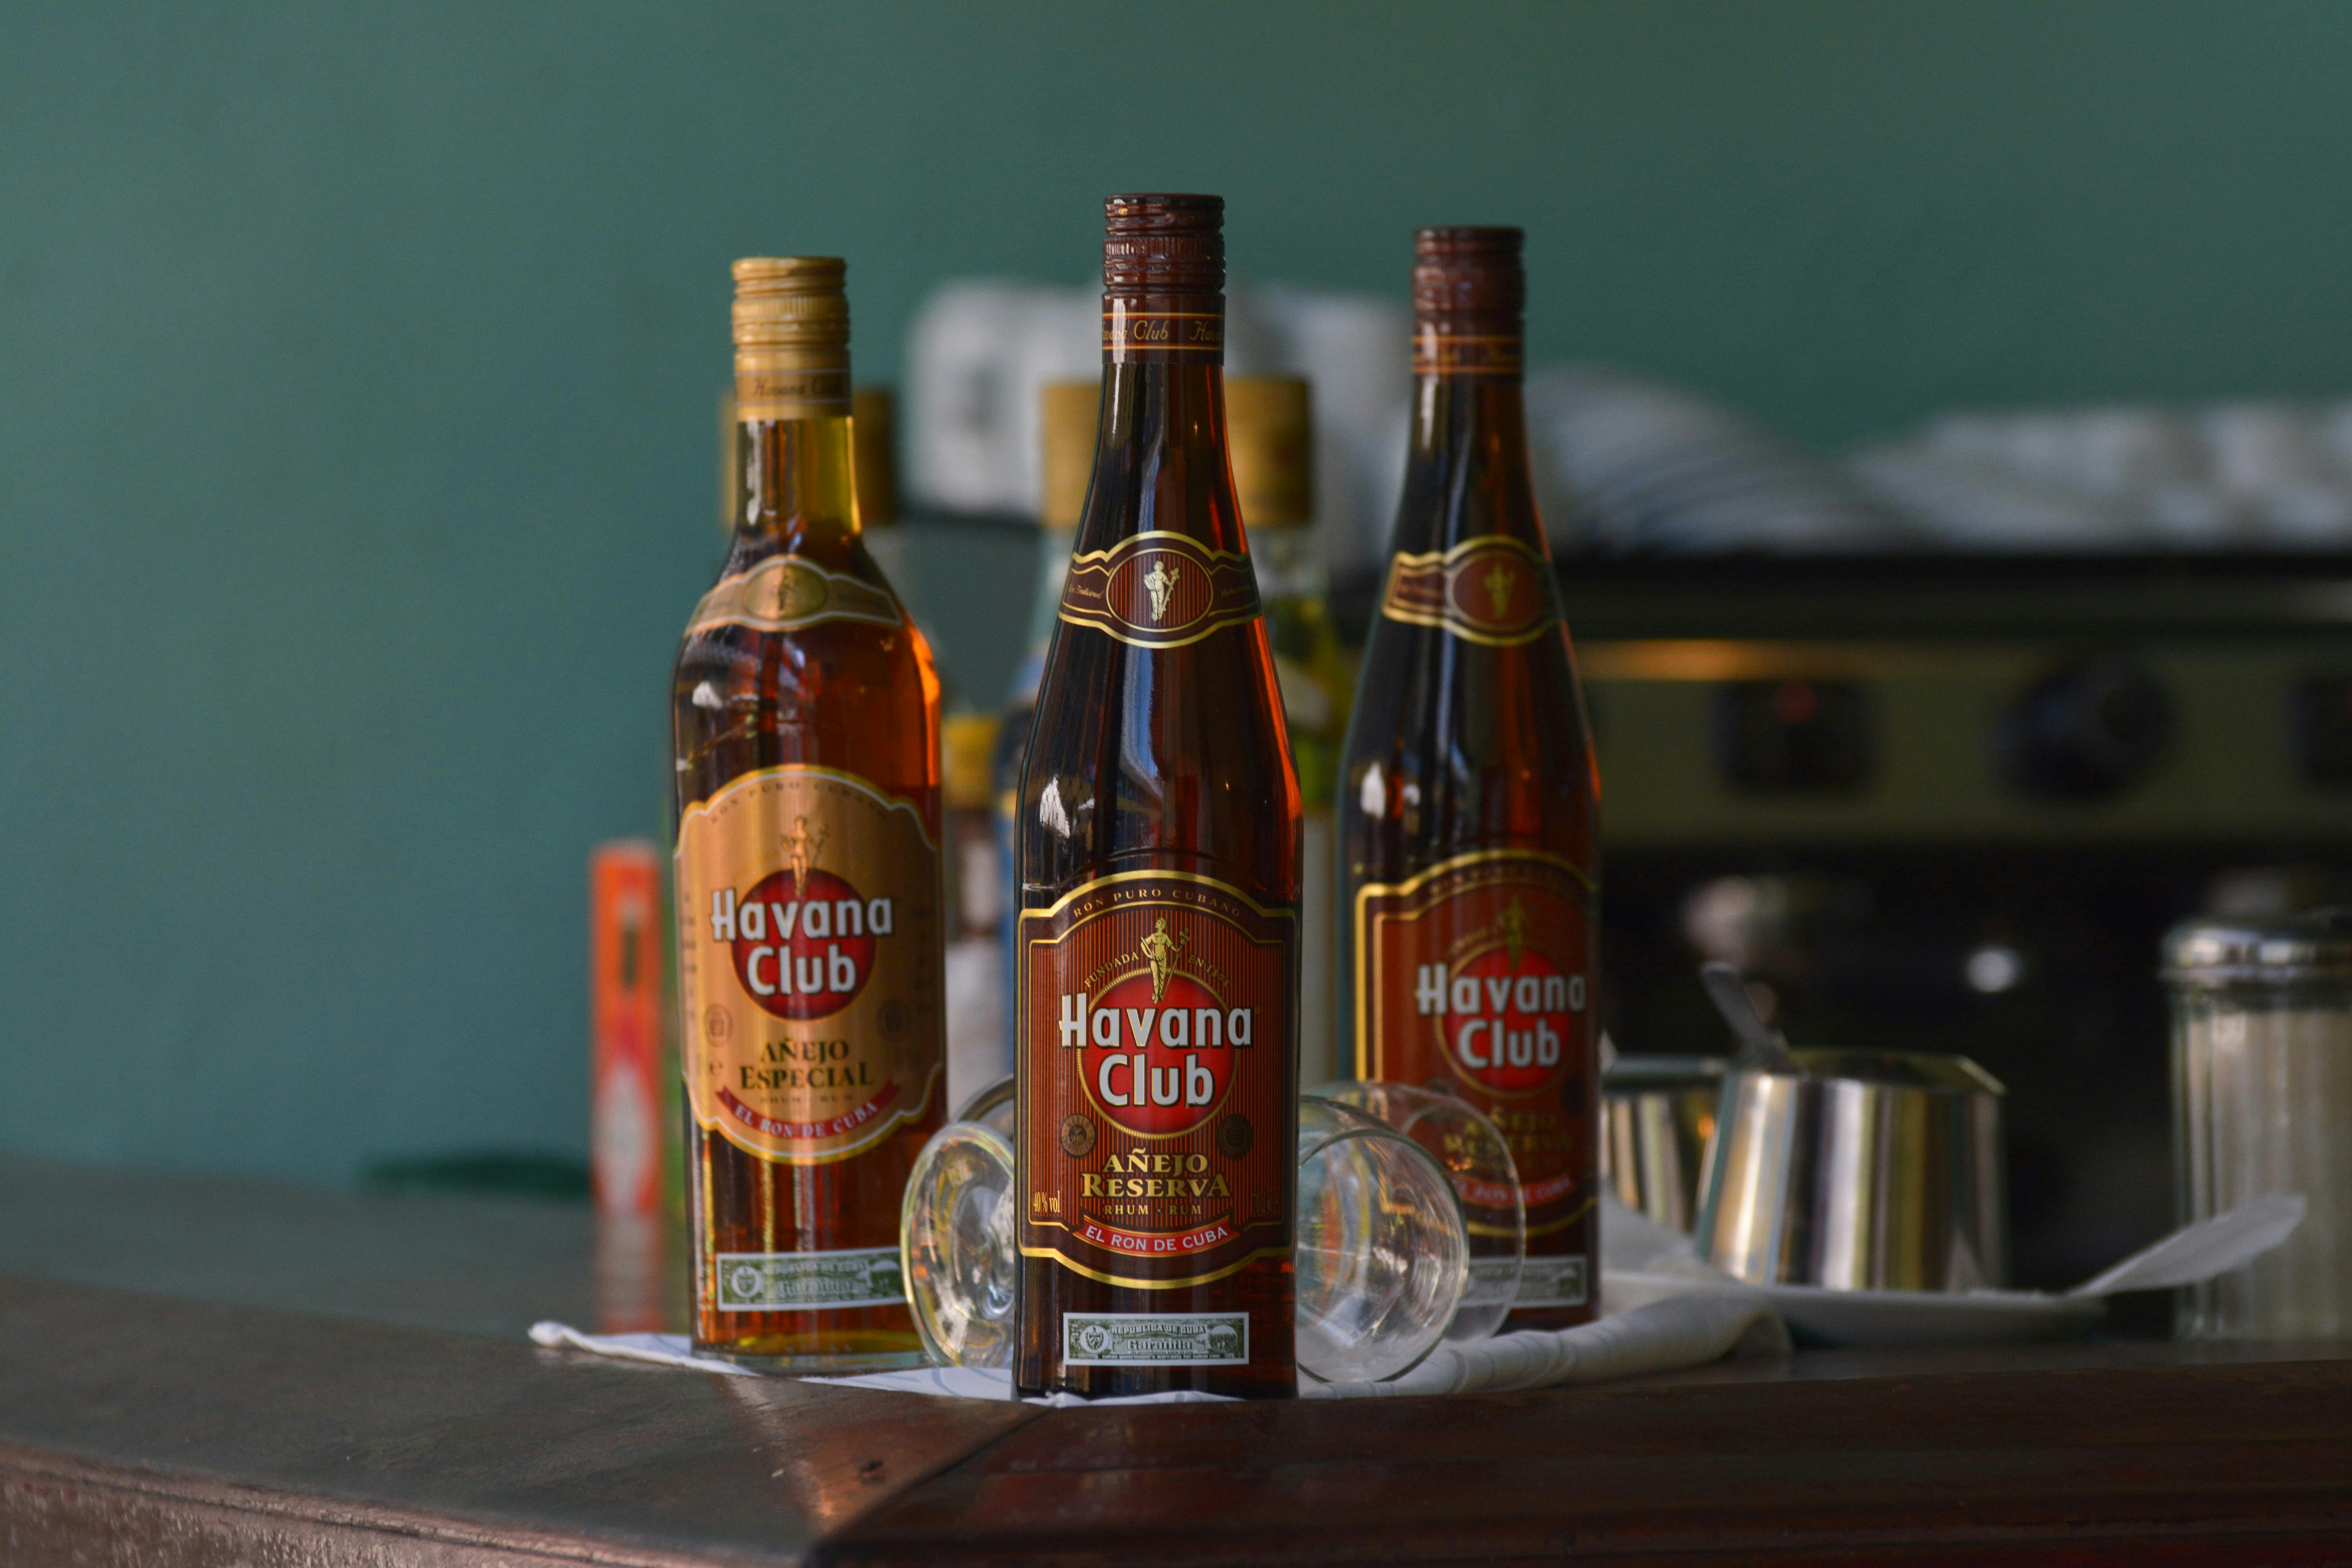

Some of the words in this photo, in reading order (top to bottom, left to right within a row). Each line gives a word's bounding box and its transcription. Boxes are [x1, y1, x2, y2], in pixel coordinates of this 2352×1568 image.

[1134, 320, 1169, 340] Club
[711, 887, 893, 941] Havana
[1074, 898, 1104, 917] RON
[1113, 889, 1161, 902] PURO
[1173, 889, 1241, 917] CUBANO
[747, 944, 857, 996] Club
[1084, 951, 1139, 988] FUNDADA
[1188, 955, 1205, 968] EN
[1206, 966, 1229, 987] 1878
[1416, 962, 1586, 1015] Havana
[1058, 993, 1252, 1047] Havana
[759, 1037, 849, 1065] AÑEJO
[1457, 1018, 1561, 1069] Club
[739, 1062, 875, 1089] ESPECIAL
[1099, 1054, 1214, 1105] Club
[735, 1104, 753, 1125] EL
[759, 1118, 793, 1138] RON
[802, 1123, 827, 1138] DE
[833, 1102, 878, 1133] CUBA
[1102, 1148, 1209, 1177] AÑEJO
[1082, 1173, 1231, 1198] RESERVA
[1105, 1205, 1149, 1215] RHUM
[1169, 1205, 1201, 1215] RUM
[1085, 1225, 1105, 1243] EL
[1111, 1234, 1147, 1250] RON
[1154, 1239, 1177, 1251] DE
[1182, 1226, 1228, 1248] CUBA
[1111, 1324, 1165, 1334] REPUBLICA
[1165, 1325, 1178, 1333] DE
[1179, 1325, 1206, 1334] CUBA
